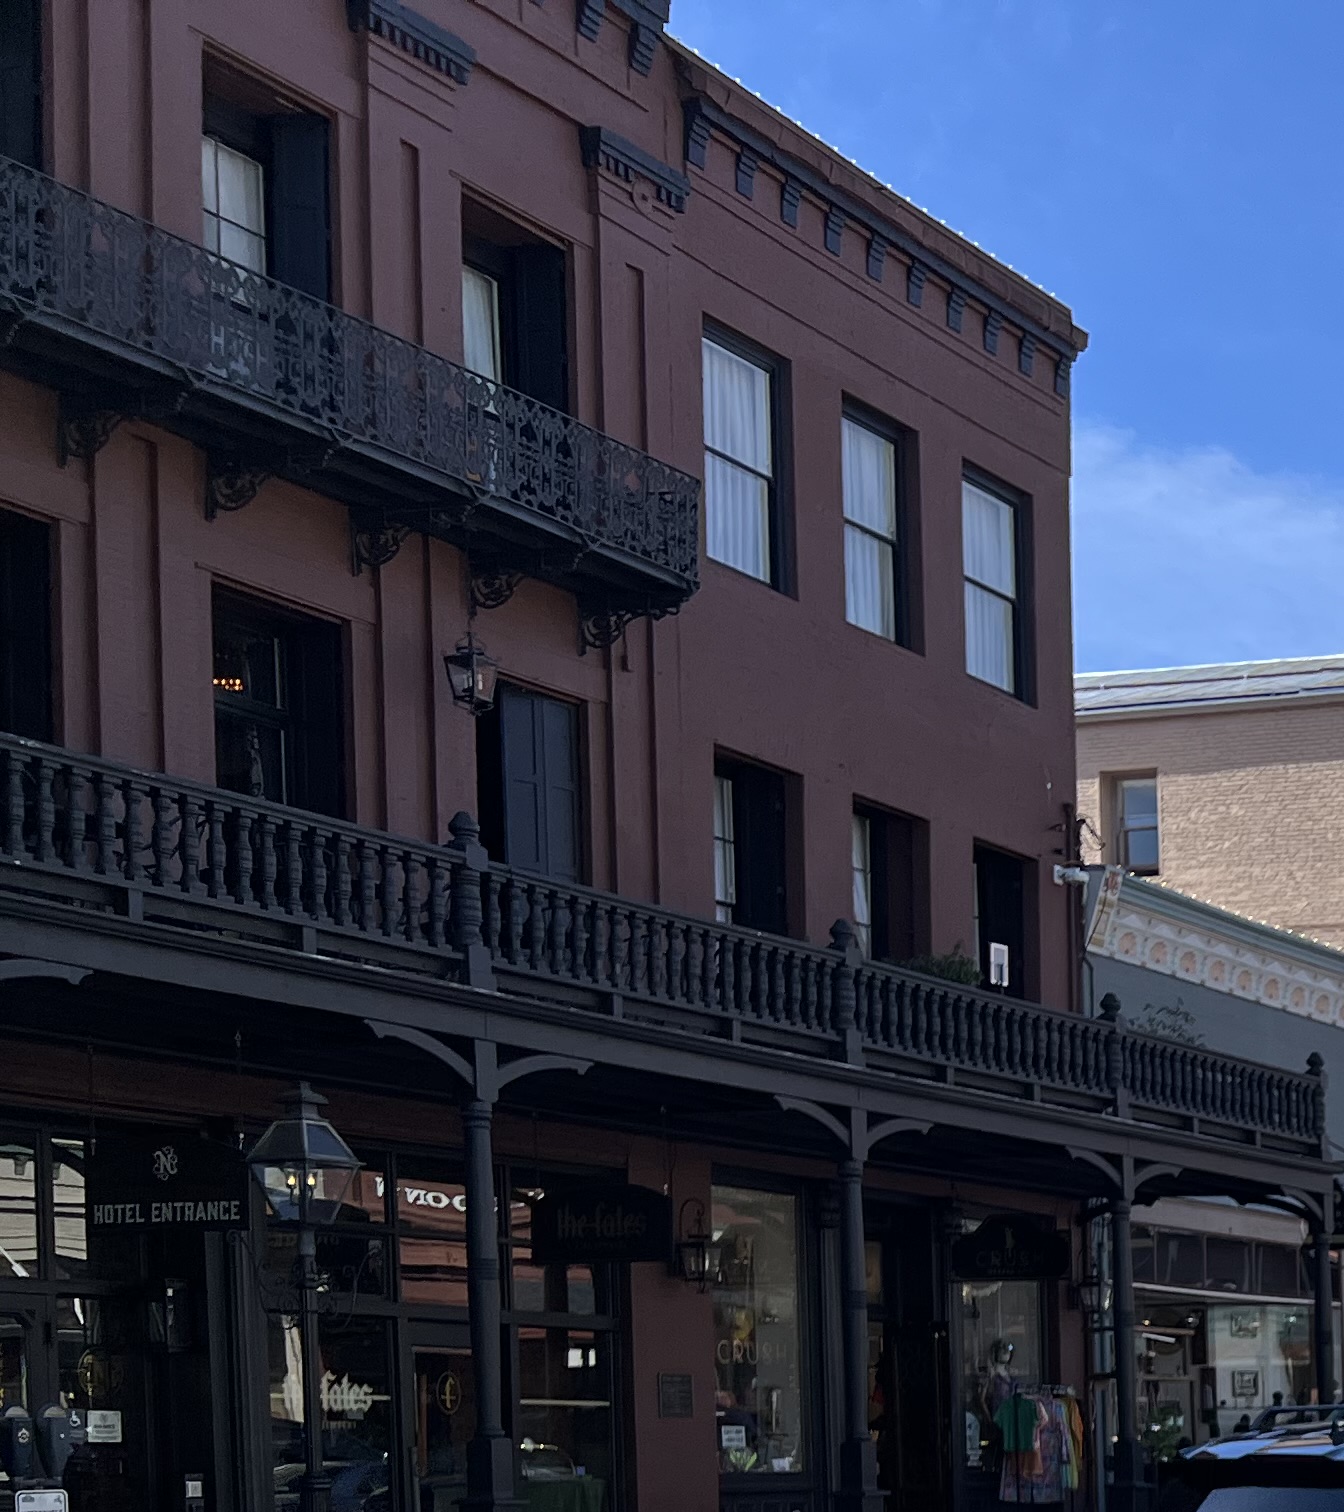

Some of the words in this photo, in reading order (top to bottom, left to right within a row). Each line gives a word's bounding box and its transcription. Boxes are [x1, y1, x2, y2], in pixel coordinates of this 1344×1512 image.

[93, 1203, 145, 1224] HOTEL
[151, 1200, 241, 1223] ENTRANCE
[717, 1339, 789, 1365] CRUSH
[320, 1370, 375, 1413] fates
